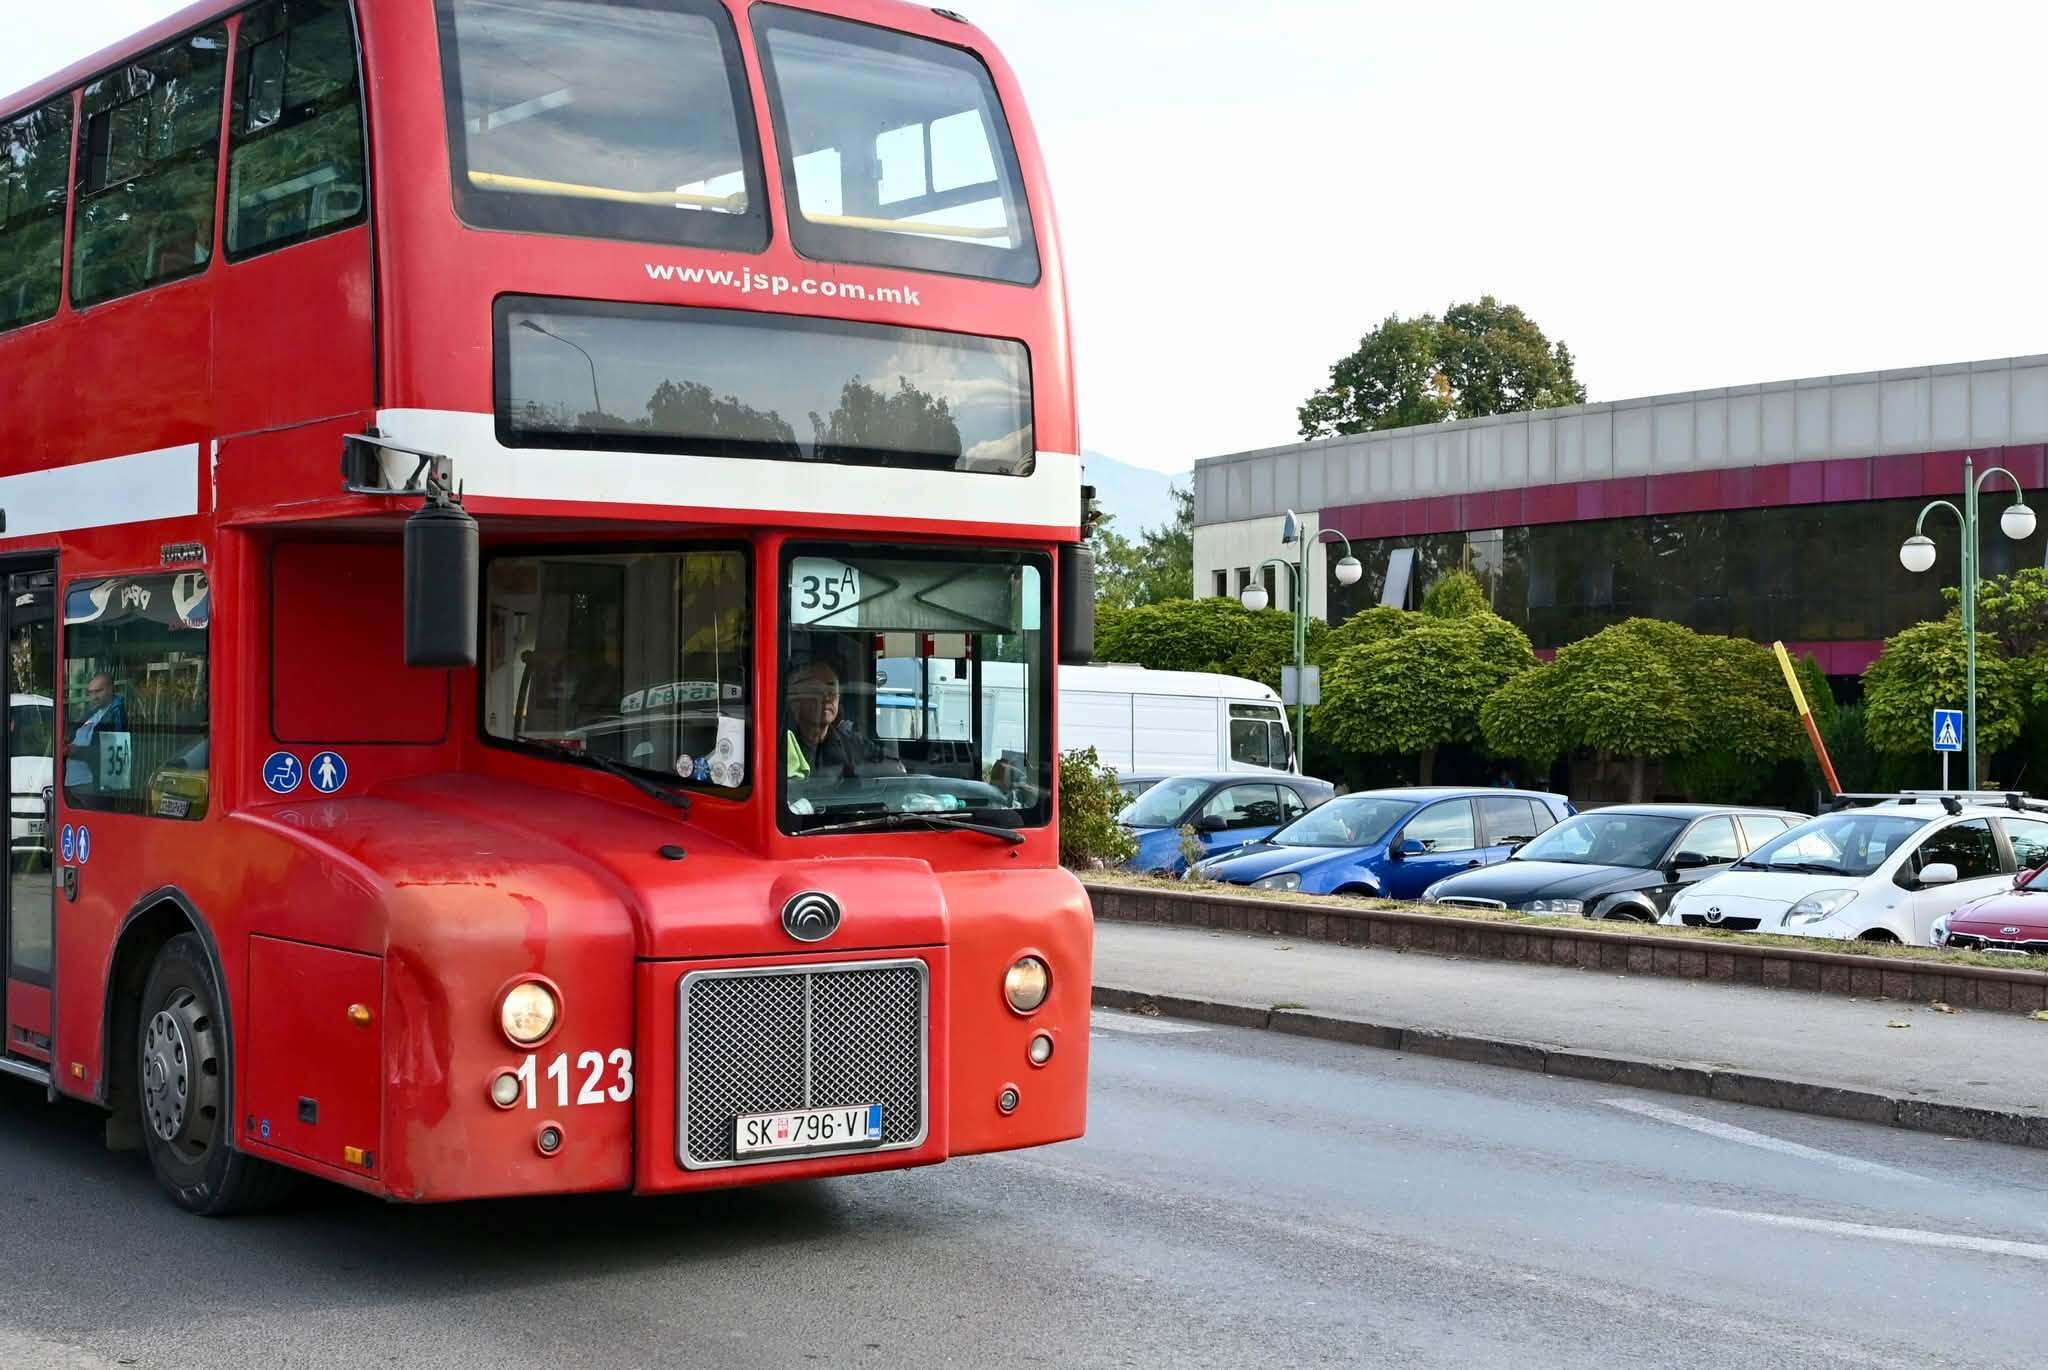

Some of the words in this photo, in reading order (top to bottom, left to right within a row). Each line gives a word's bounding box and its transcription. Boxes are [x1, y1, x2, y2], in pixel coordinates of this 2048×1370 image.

[645, 263, 921, 306] www.jsp.com.mk
[517, 1047, 634, 1110] 1123
[747, 1118, 773, 1146] SK
